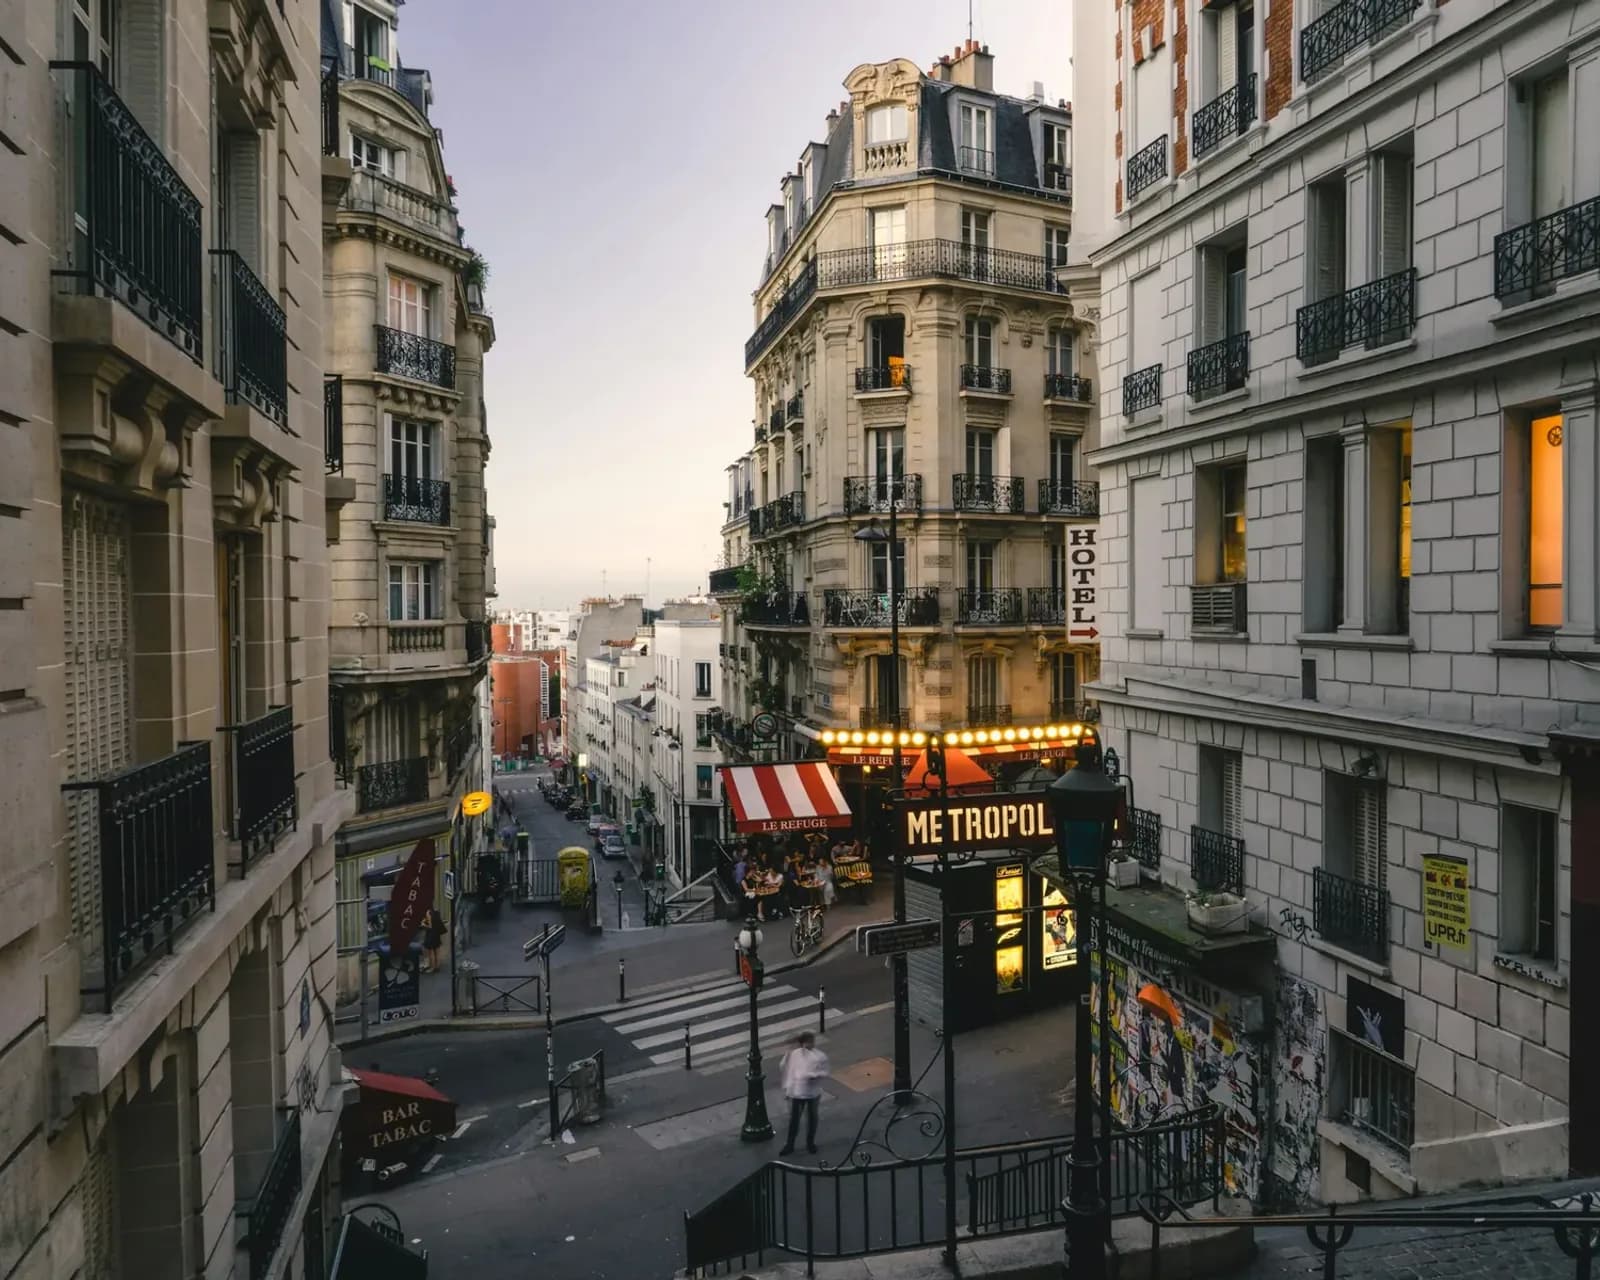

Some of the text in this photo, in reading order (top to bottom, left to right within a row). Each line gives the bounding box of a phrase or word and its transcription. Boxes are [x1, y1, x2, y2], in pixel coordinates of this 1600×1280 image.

[1070, 529, 1096, 624] HOTEL
[853, 755, 910, 766] LE REFUE
[762, 818, 828, 831] LE REFUGE
[400, 861, 425, 929] TABAC
[1428, 919, 1466, 945] UPR.fr
[383, 1007, 417, 1021] LOTO
[383, 1101, 420, 1125] BAR
[369, 1119, 432, 1149] TABAC
